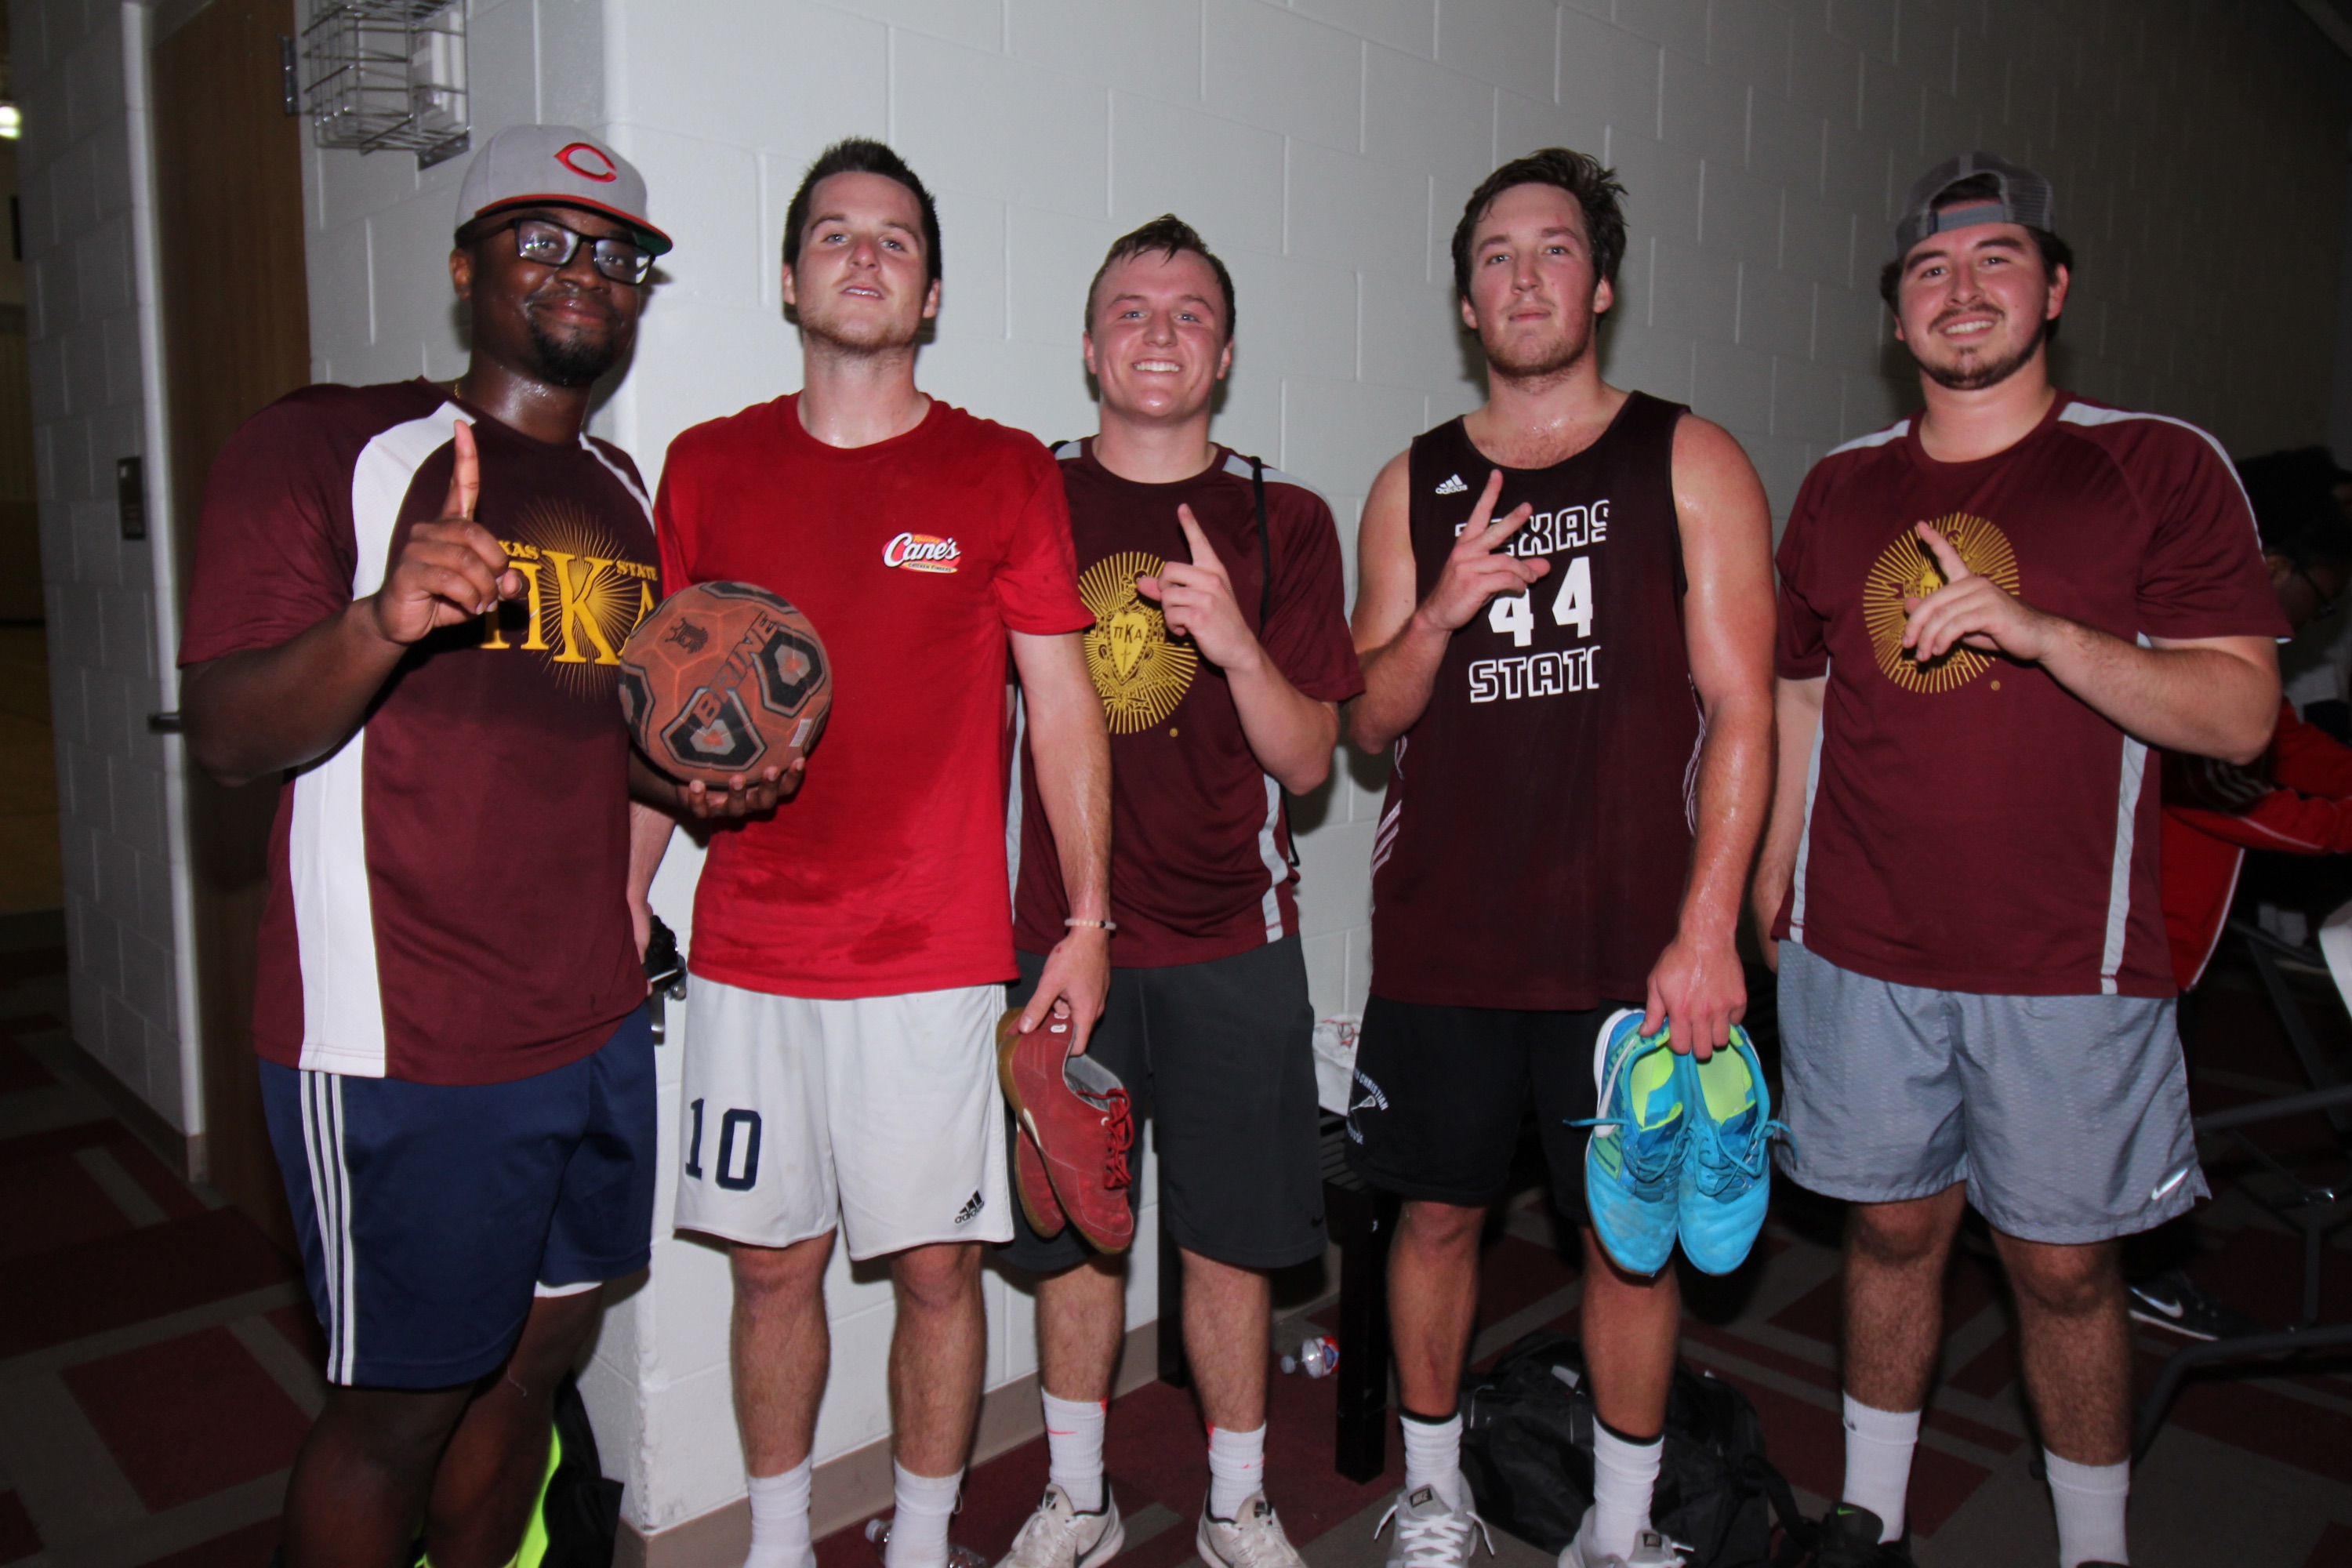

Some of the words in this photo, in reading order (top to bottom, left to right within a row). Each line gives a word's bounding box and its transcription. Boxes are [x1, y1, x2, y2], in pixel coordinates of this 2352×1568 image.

[1436, 484, 1468, 495] adidas
[884, 532, 961, 568] Cane's
[1455, 499, 1610, 557] XAS
[1488, 556, 1594, 648] 44
[1359, 1073, 1389, 1111] CHRISTIAN
[685, 1098, 762, 1192] 10
